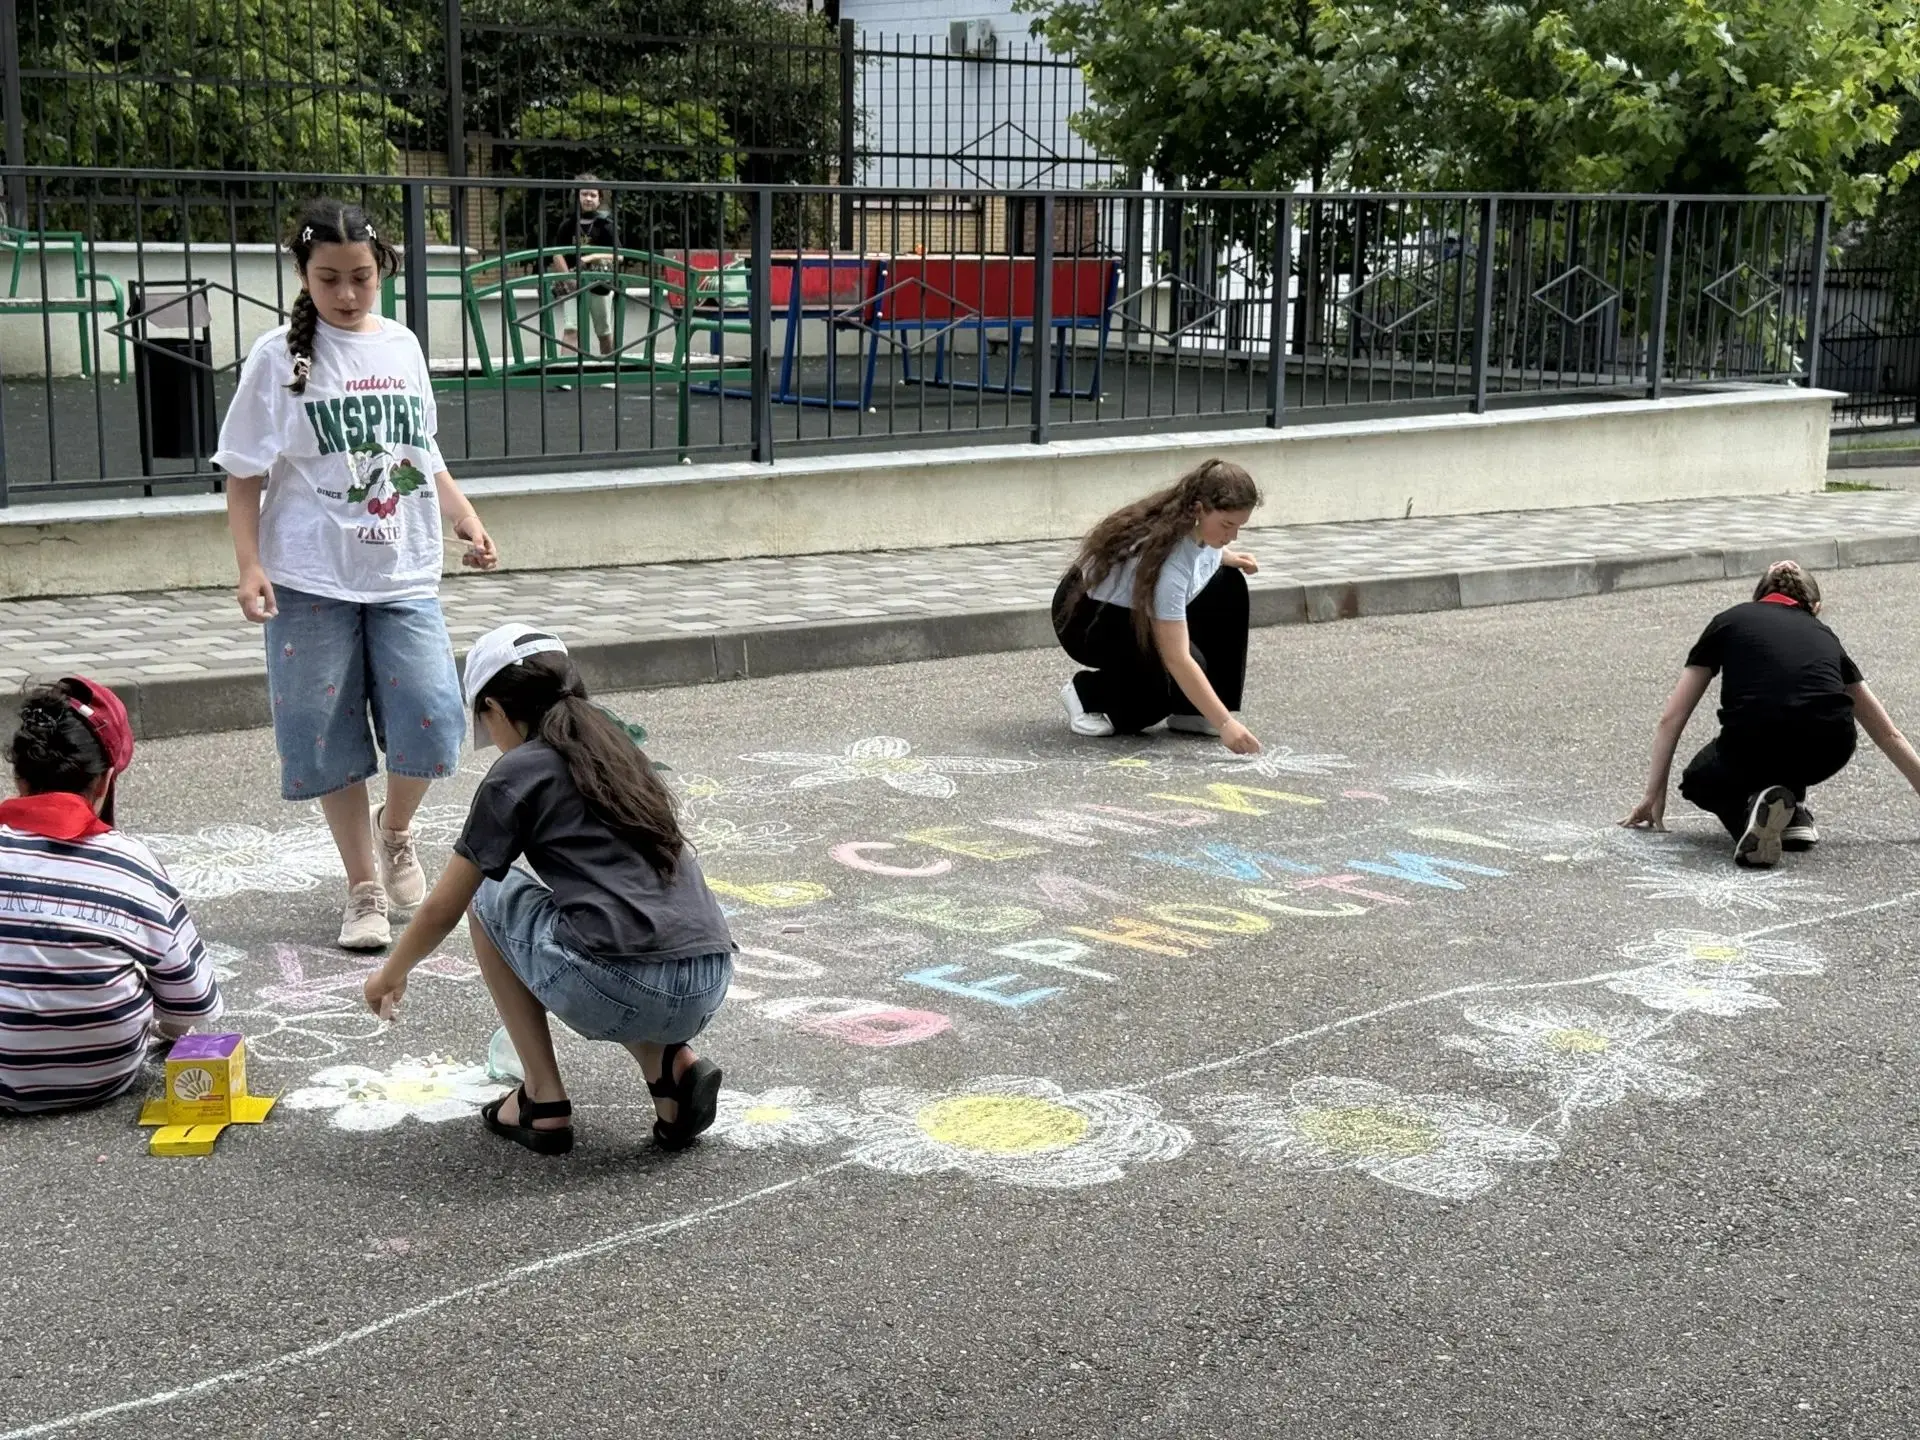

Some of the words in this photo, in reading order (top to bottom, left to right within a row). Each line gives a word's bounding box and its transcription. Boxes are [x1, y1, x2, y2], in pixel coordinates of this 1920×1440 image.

[345, 375, 407, 393] nature
[304, 394, 431, 456] INSPIRE
[317, 487, 343, 500] SINCE
[356, 525, 402, 541] TASTE
